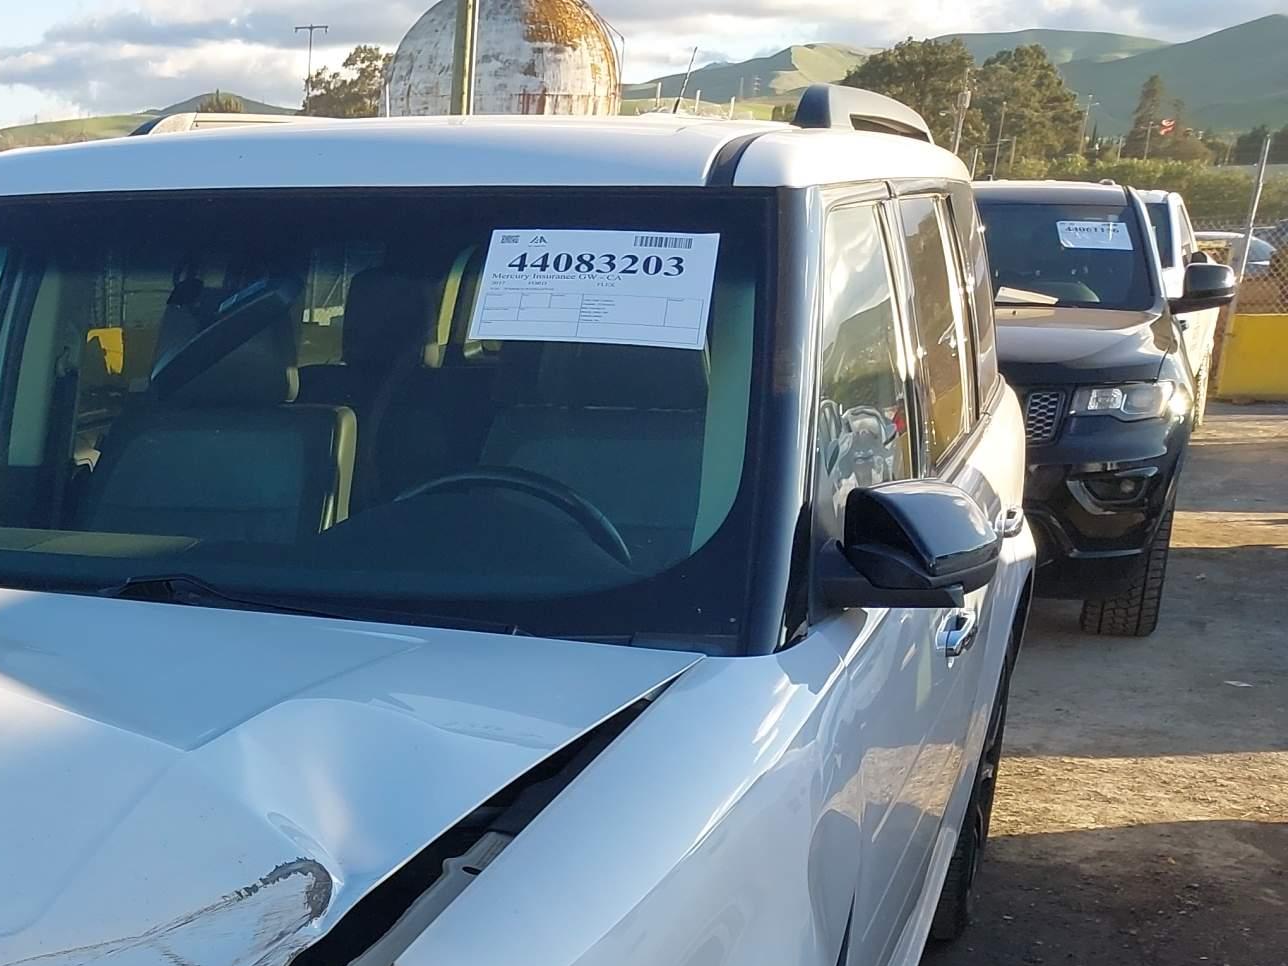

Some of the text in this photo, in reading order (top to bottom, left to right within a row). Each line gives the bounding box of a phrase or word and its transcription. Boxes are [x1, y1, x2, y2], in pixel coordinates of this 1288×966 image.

[508, 252, 685, 276] 44083203
[492, 272, 530, 281] Mercury
[532, 272, 576, 281] Insurance
